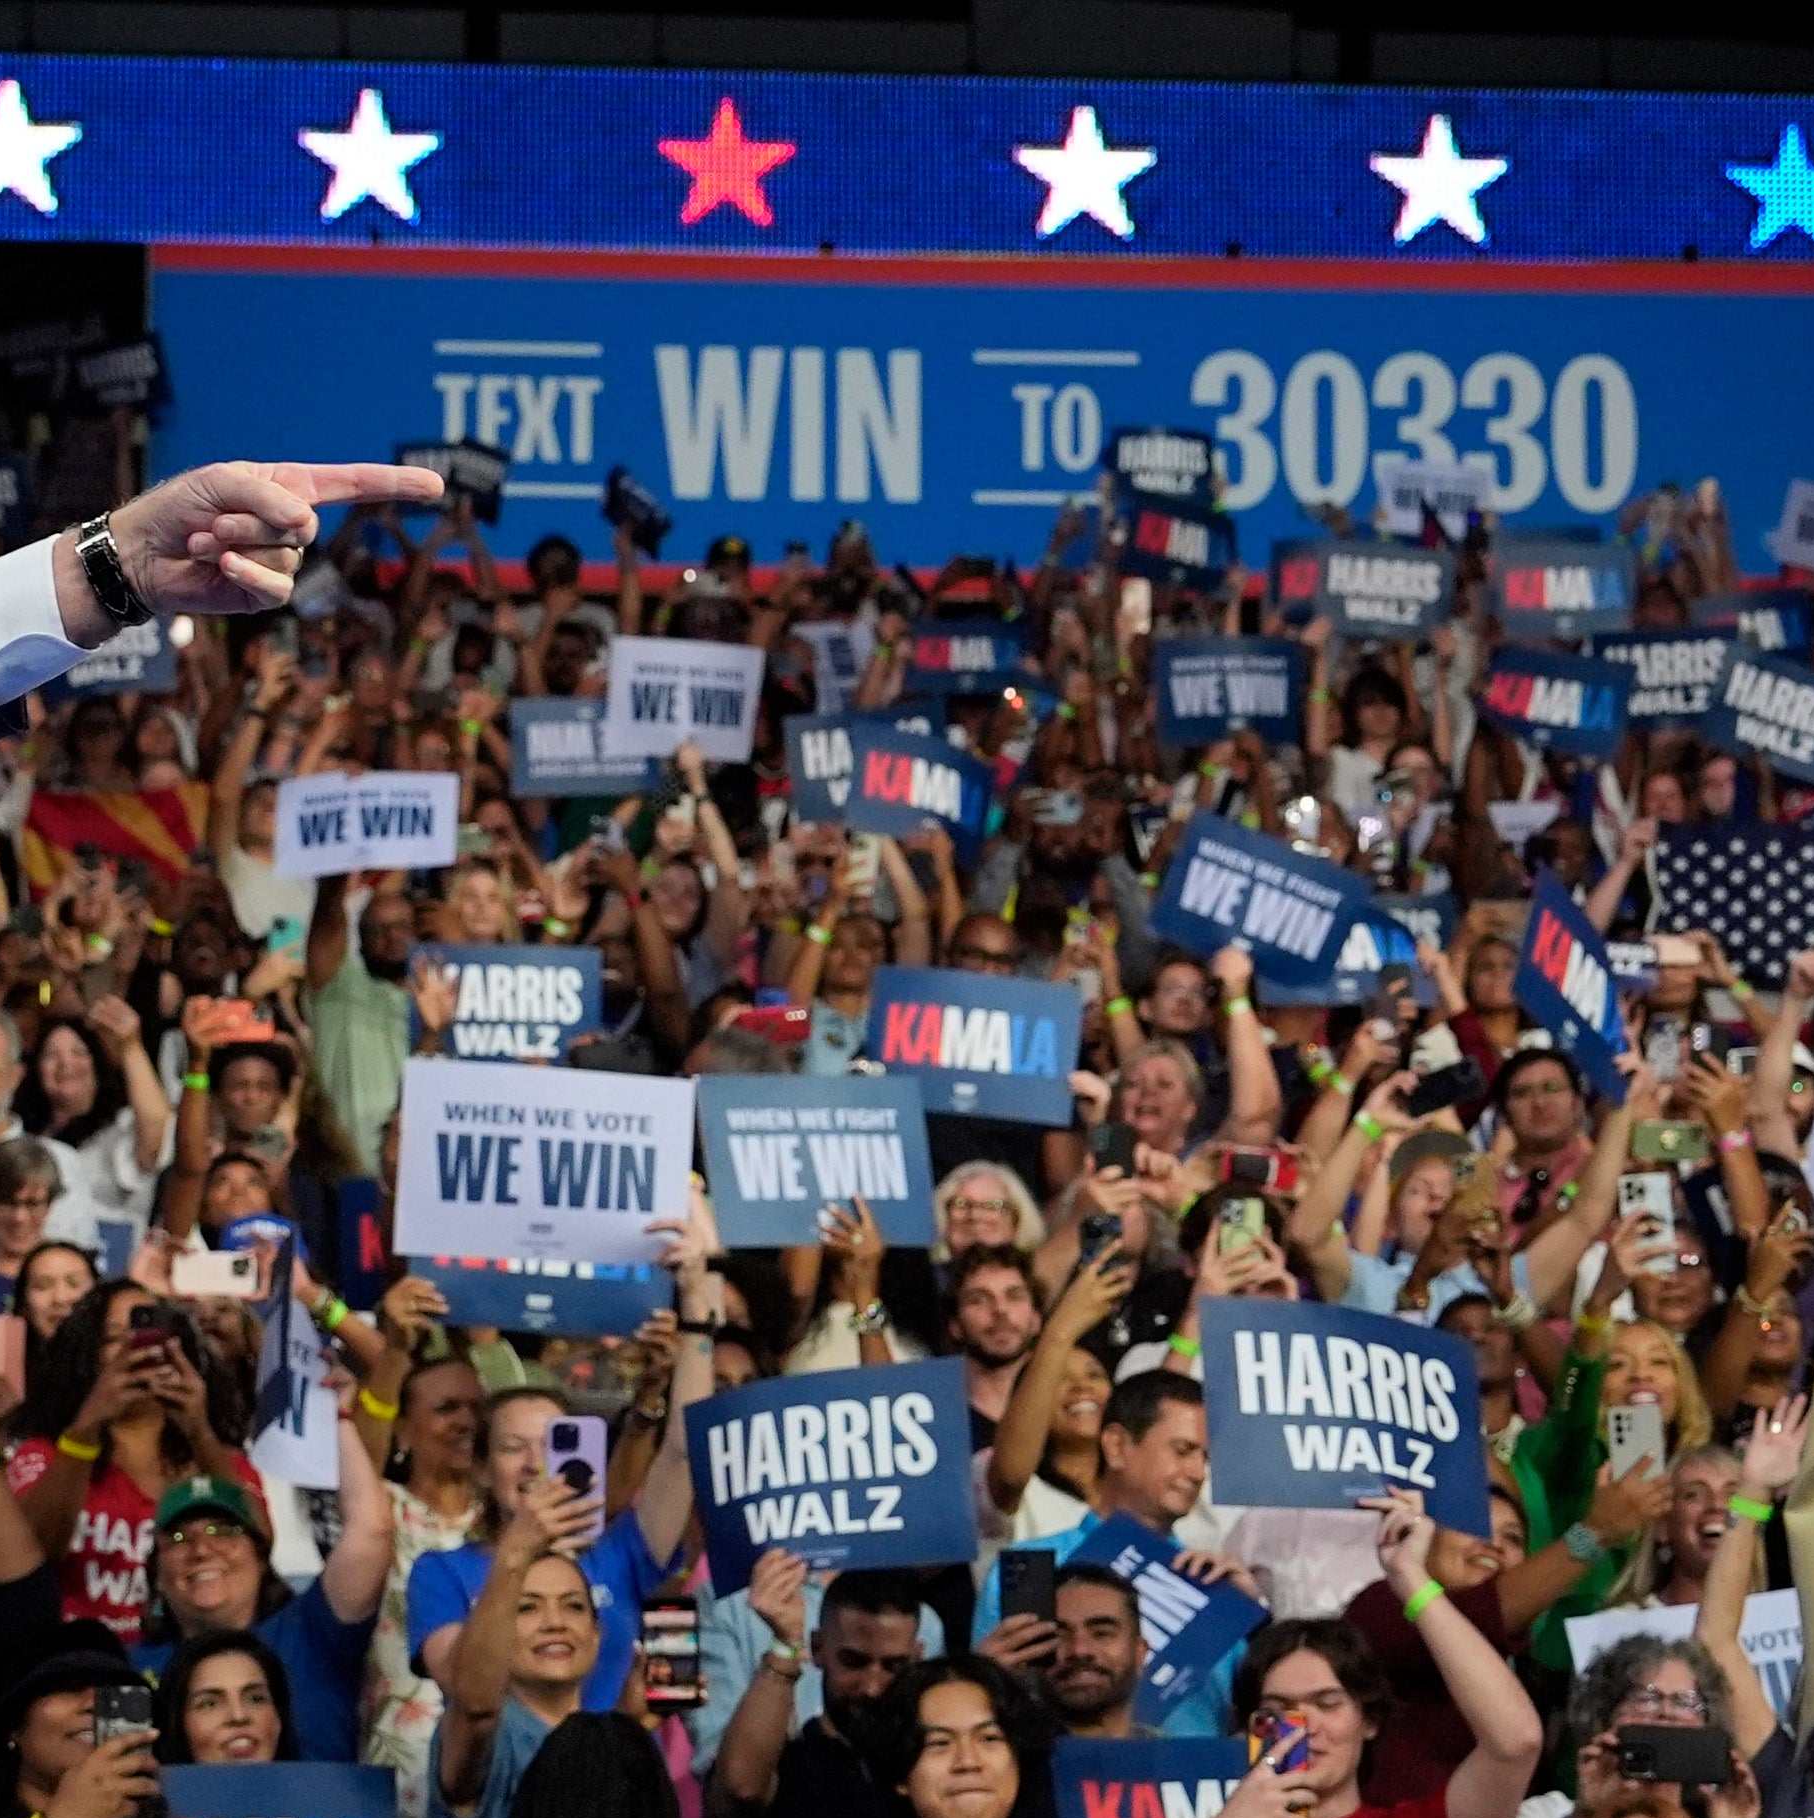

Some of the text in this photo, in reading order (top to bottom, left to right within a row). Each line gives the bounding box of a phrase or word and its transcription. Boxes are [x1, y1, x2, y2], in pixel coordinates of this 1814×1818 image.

[433, 375, 602, 464] TEXT
[655, 347, 922, 503] WIN
[1011, 385, 1102, 470] TO
[1189, 351, 1639, 513] 30330
[1327, 554, 1442, 602] HARRIS
[631, 681, 747, 729] WE WIN
[1169, 674, 1222, 719] WE
[299, 801, 434, 850] WE WIN
[1180, 856, 1252, 926] WE
[1243, 880, 1336, 963] WIN
[453, 1020, 562, 1062] WALZ
[882, 1001, 1058, 1079] KAMALA
[444, 1102, 653, 1135] WHEN WE VOTE
[837, 1107, 898, 1130] FIGHT
[437, 1132, 658, 1213] WE WIN
[727, 1134, 911, 1203] WE WIN
[1233, 1329, 1460, 1444] HARRIS
[707, 1390, 938, 1507] HARRIS
[1284, 1422, 1435, 1491] WALZ
[744, 1485, 905, 1546] WALZ
